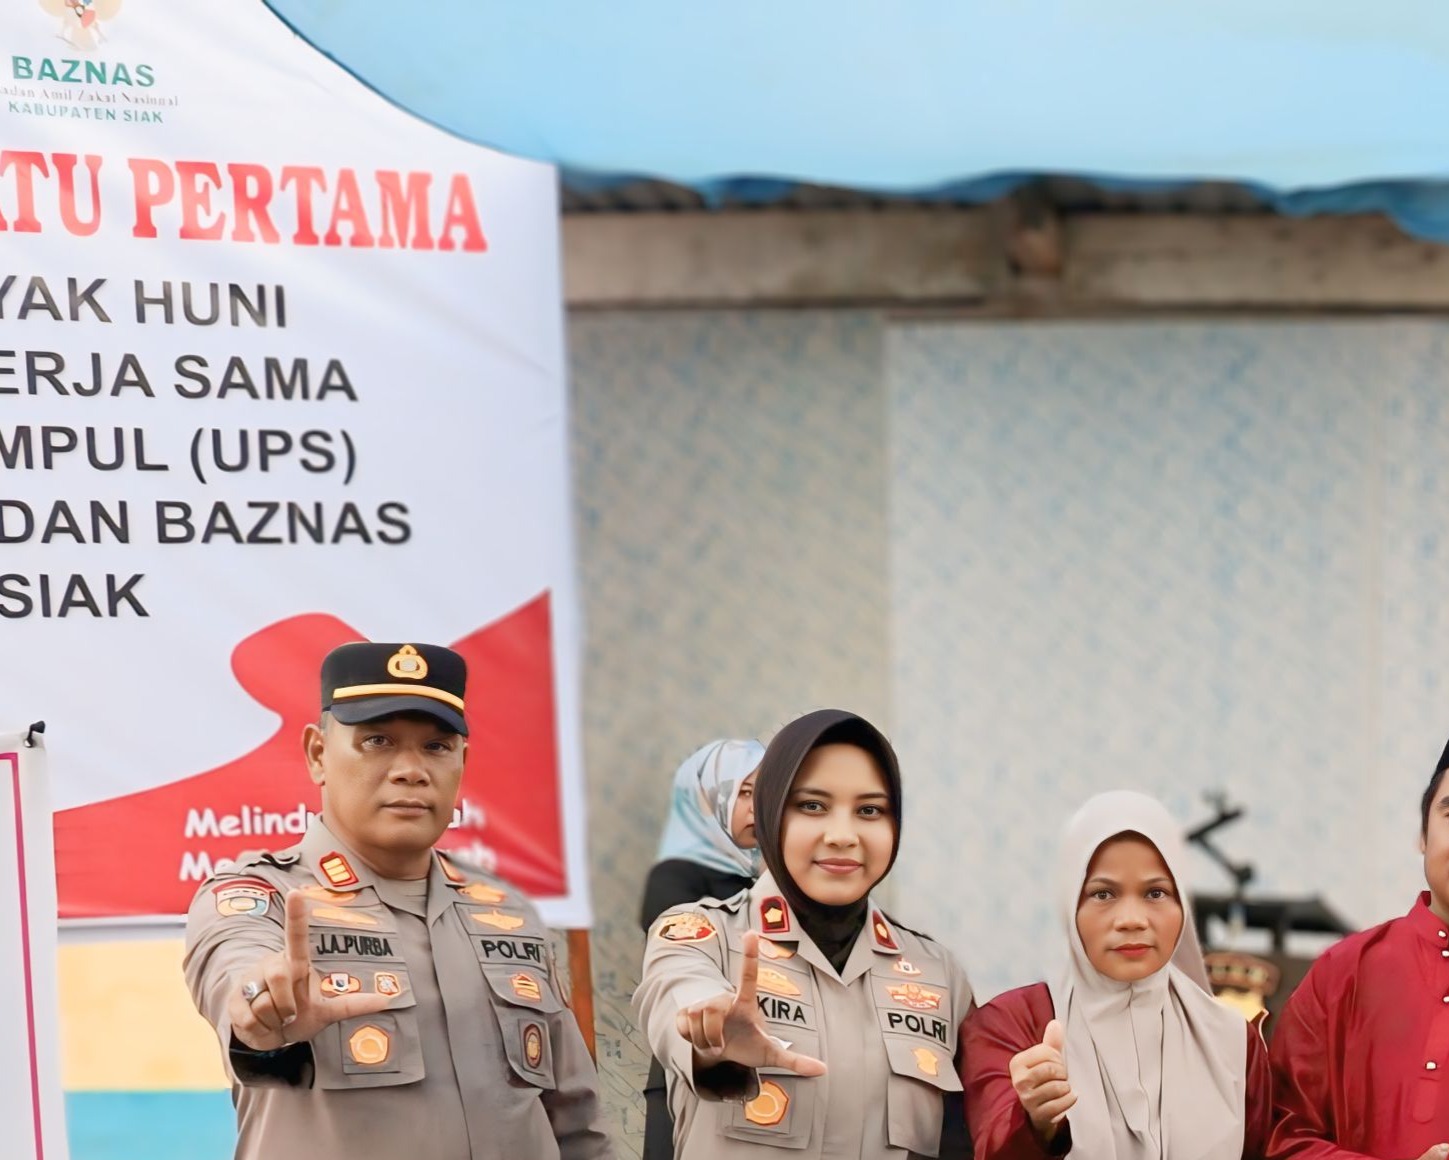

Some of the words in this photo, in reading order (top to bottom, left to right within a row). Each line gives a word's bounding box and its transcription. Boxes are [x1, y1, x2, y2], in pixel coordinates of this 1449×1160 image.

[12, 56, 155, 87] BAZNAS
[9, 101, 117, 121] KABUPATEN
[123, 109, 163, 123] SIAK
[0, 150, 103, 237] TU
[127, 158, 488, 253] PERTAMA
[134, 279, 287, 328] HUNI
[173, 354, 359, 402] SAMA
[190, 427, 357, 485] (UPS)
[0, 500, 131, 545] DAN
[156, 501, 412, 545] BAZNAS
[0, 573, 150, 618] SIAK
[481, 939, 541, 963] POLRI
[756, 995, 807, 1025] KIRA
[886, 1011, 947, 1045] POLRI
